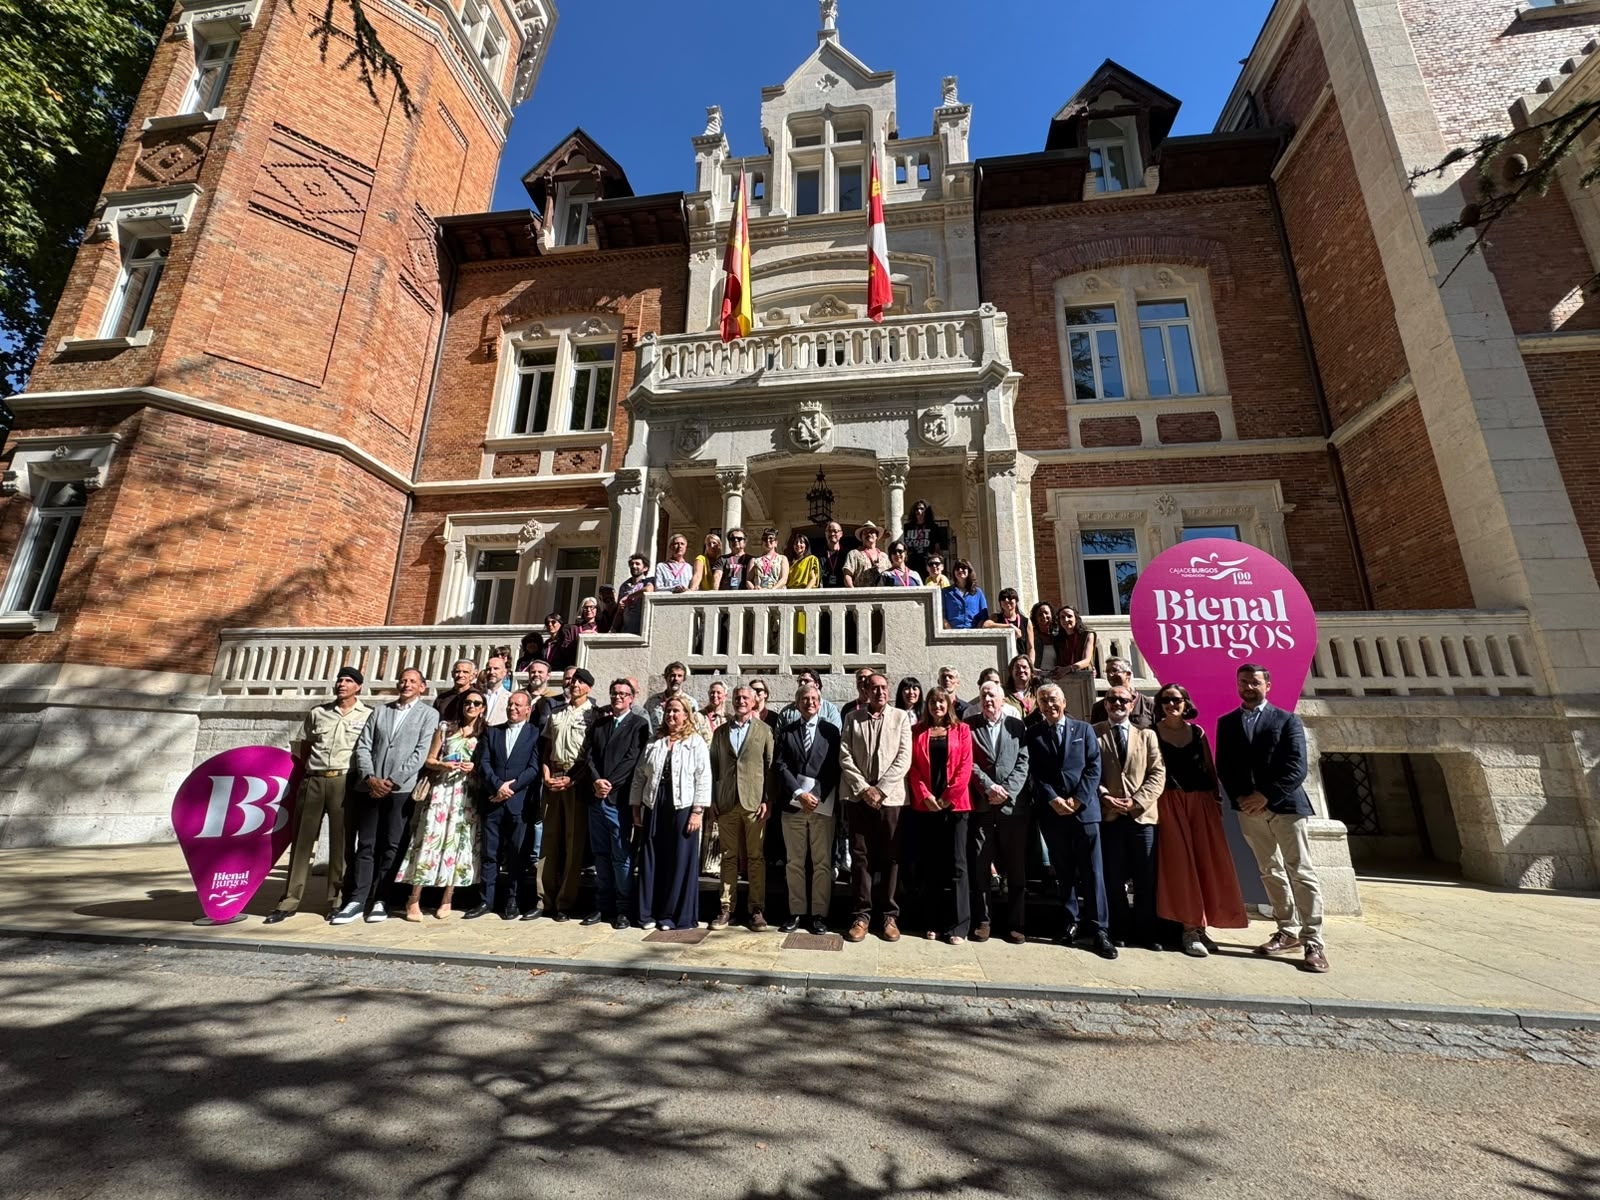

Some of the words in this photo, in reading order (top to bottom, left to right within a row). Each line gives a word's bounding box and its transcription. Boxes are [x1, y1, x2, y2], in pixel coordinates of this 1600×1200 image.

[1233, 571, 1251, 585] 100
[1152, 588, 1290, 622] Bienal
[1156, 623, 1295, 659] Burgos
[213, 870, 250, 881] Bienal
[211, 879, 249, 890] Burgos
